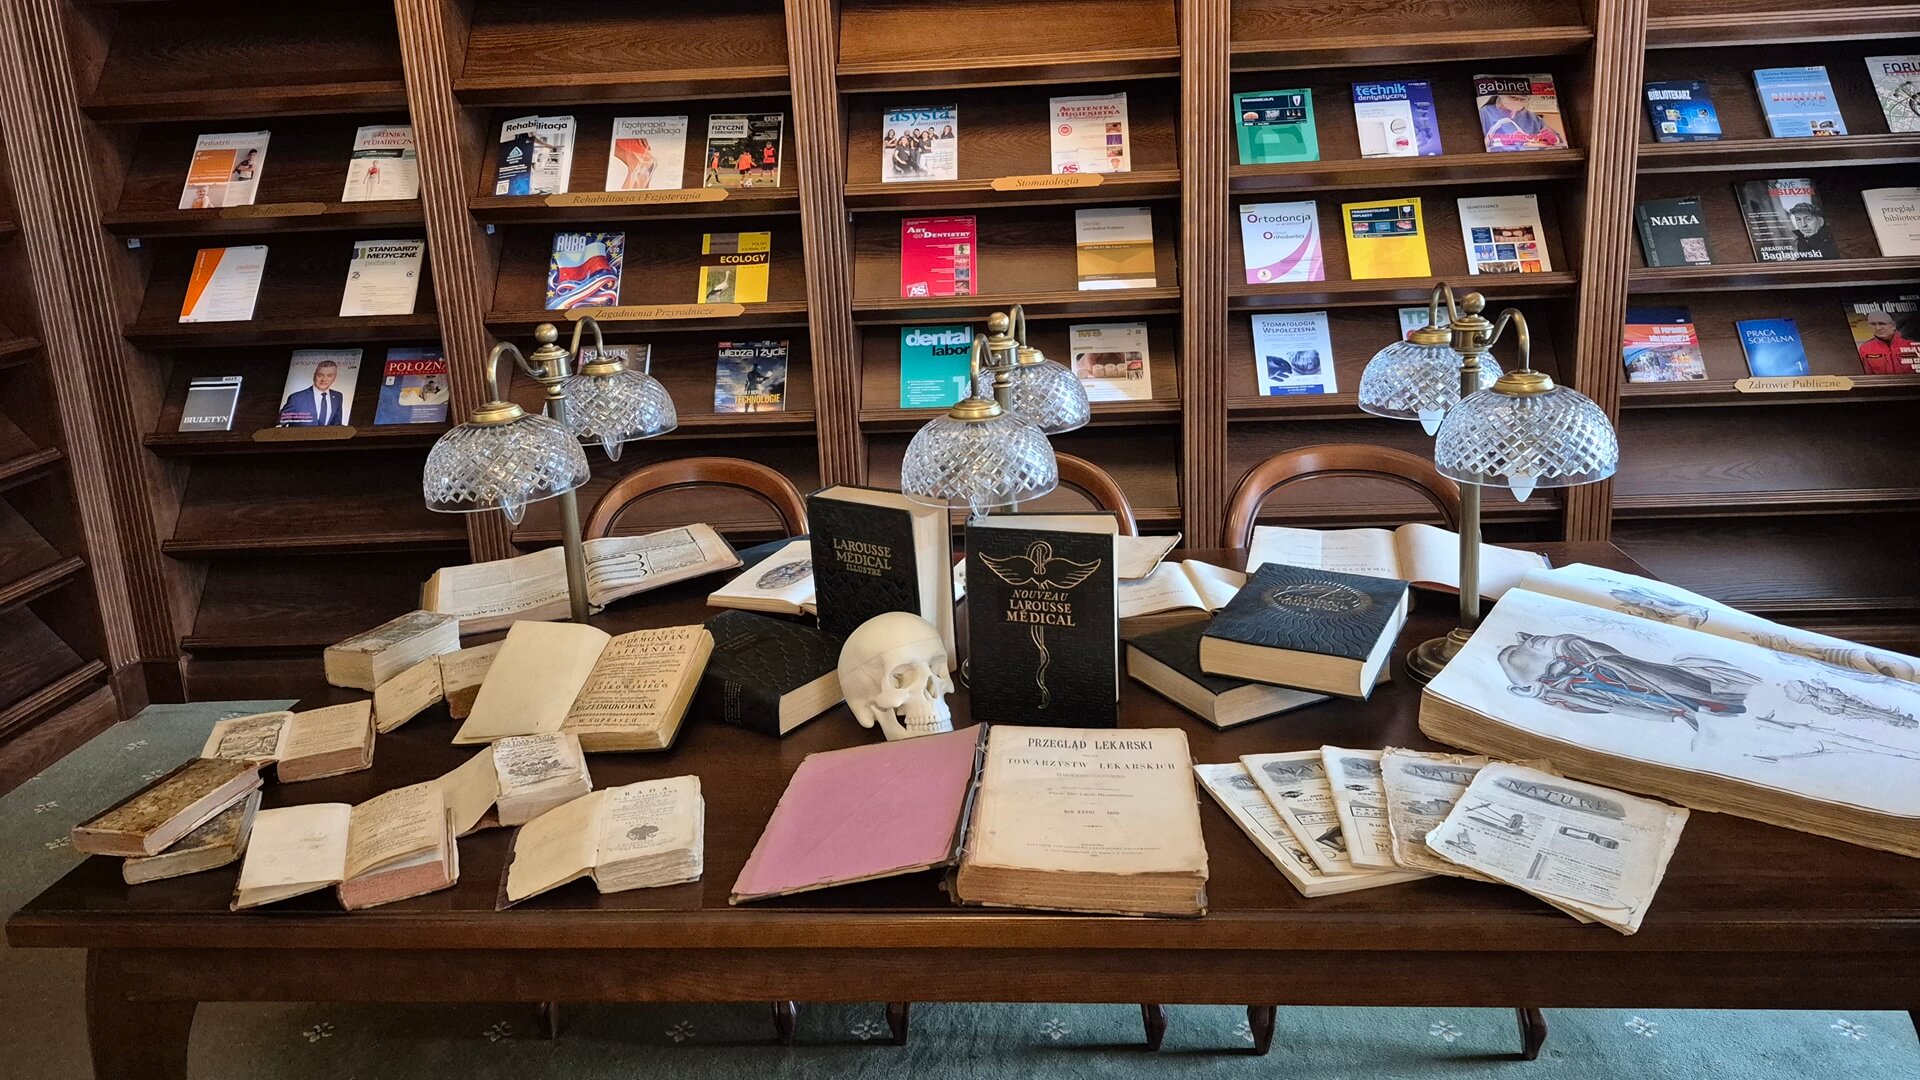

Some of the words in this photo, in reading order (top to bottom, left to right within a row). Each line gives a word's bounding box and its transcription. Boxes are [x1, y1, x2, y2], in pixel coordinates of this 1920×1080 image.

[1356, 84, 1406, 96] technik
[1478, 80, 1530, 94] gabinet
[1358, 93, 1407, 101] dentystyczny
[1647, 90, 1692, 101] BIBLIOTEKARZ
[1060, 104, 1116, 112] ASYSTENTKA
[1061, 110, 1120, 118] HIGIENISTKA
[620, 120, 666, 130] fizjoterapia
[632, 126, 681, 136] rehabilitacja
[1015, 176, 1080, 188] Stomatologia
[572, 192, 635, 204] Rehabilitacja
[644, 191, 702, 203] Fizjoterapia
[1882, 204, 1916, 214] przegląd
[1247, 213, 1312, 224] Ortodoncja
[1650, 214, 1700, 226] NAUKA
[906, 226, 926, 234] ART
[556, 234, 587, 252] AURA
[366, 252, 418, 260] MEDYCZNE
[720, 254, 766, 264] ECOLOGY
[364, 259, 396, 268] pediatria
[594, 308, 653, 320] Zagadnienia
[656, 307, 715, 318] Przyrodnicze
[1262, 320, 1316, 328] STOMATOLOGIA
[1262, 326, 1316, 334] WSPÓŁCZESNA
[1746, 329, 1776, 338] PRACA
[906, 326, 971, 347] dental
[1748, 335, 1794, 345] SOCJALNA
[584, 348, 628, 358] SCINTIFIC
[932, 344, 971, 356] labor
[1796, 360, 1803, 372] 1
[952, 376, 966, 400] 1
[1748, 380, 1789, 390] Zdrowie
[1792, 379, 1841, 388] Publiczne
[734, 394, 781, 404] TECHNOLOGIE
[183, 415, 229, 424] BIULETYN
[832, 538, 892, 558] LAROUSSE
[836, 550, 892, 570] MÉDICAL
[1012, 588, 1070, 602] NOUVEAU
[1010, 599, 1072, 614] LAROUSSE
[1006, 610, 1076, 627] MÉDICAL
[1028, 737, 1088, 751] PRZEGLĄD
[1095, 740, 1153, 750] LEKARSKI
[1007, 758, 1088, 768] TOWARZYSTW
[1099, 762, 1176, 770] LEKARSKICH
[624, 786, 668, 796] RADA
[1507, 780, 1612, 813] NATURE
